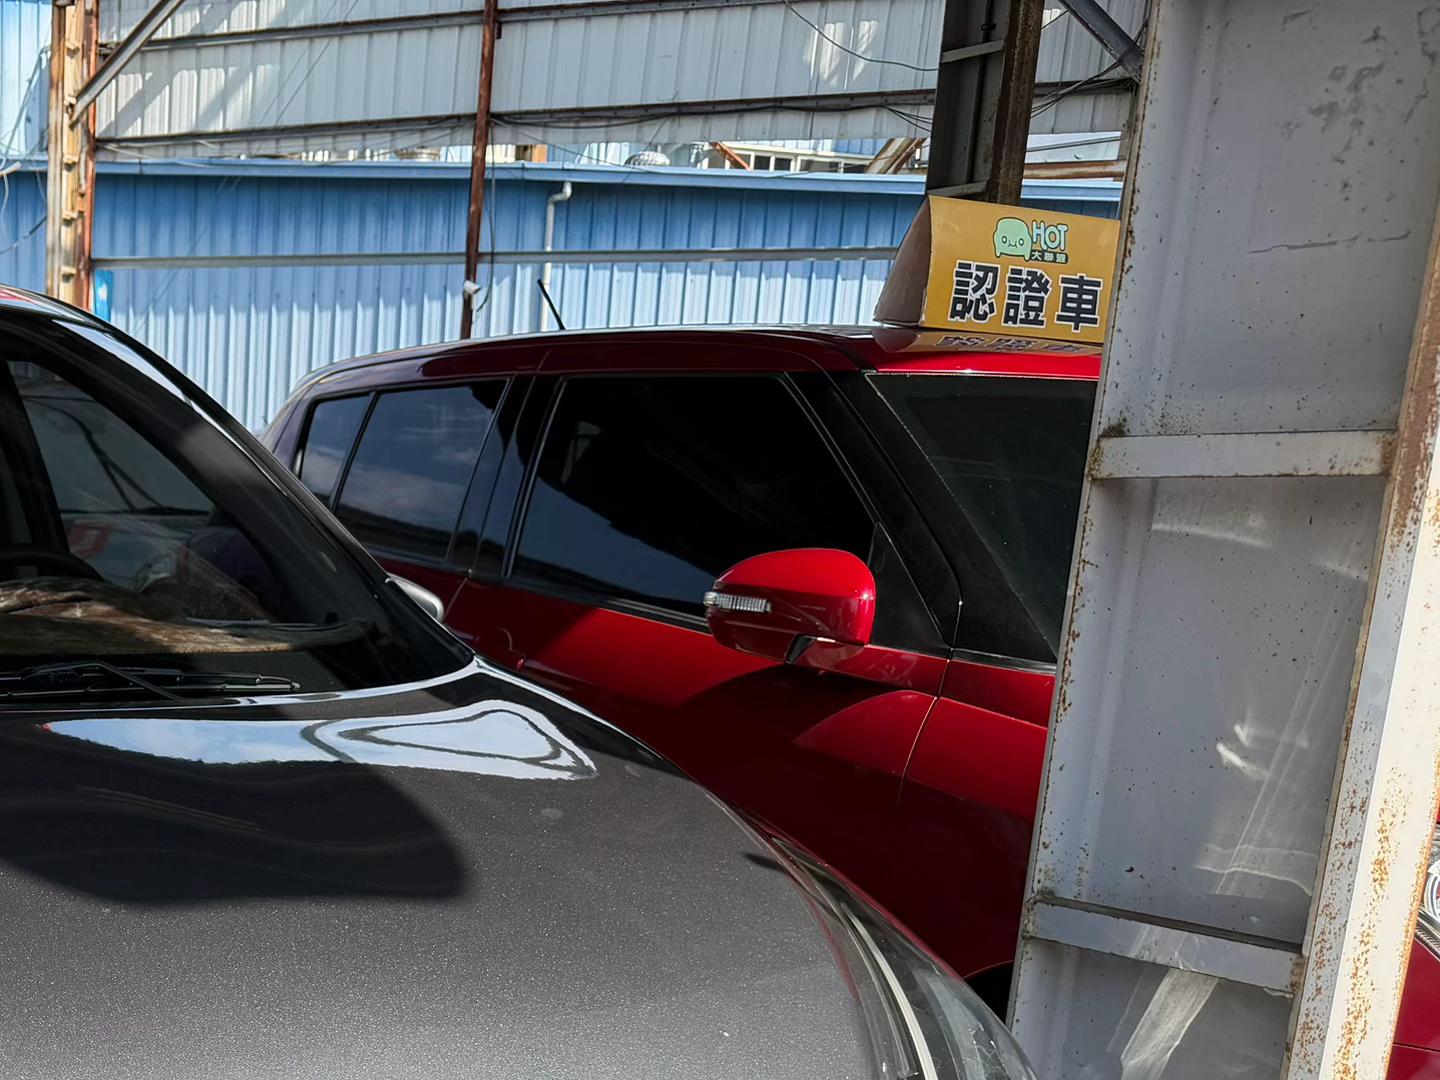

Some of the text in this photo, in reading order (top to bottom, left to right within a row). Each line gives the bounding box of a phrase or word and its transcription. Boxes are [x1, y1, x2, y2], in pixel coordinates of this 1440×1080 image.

[1030, 220, 1069, 251] HOT
[948, 260, 1103, 332] 認證車
